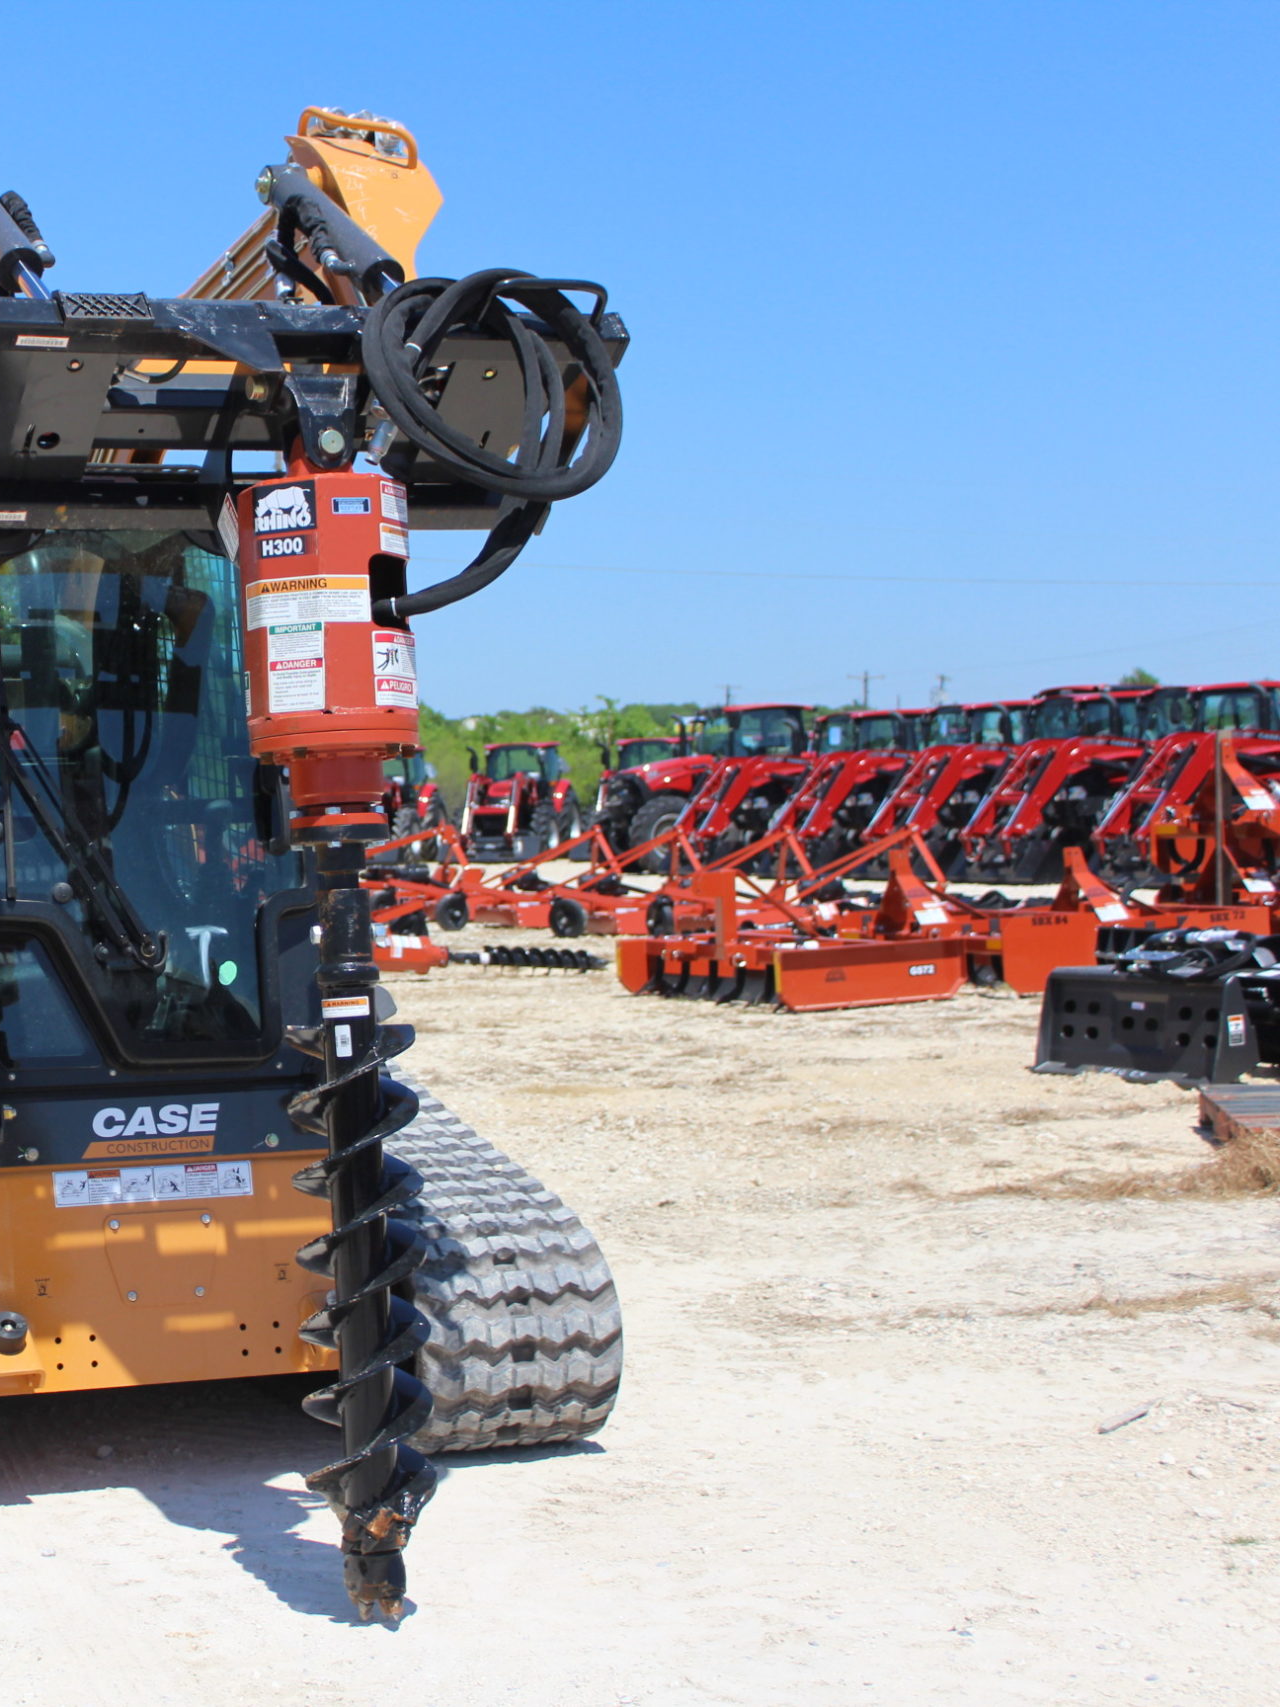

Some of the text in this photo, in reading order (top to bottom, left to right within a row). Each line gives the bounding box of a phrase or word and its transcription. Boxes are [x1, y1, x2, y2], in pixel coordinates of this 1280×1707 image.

[261, 537, 303, 556] H300
[270, 578, 327, 591] WARNING
[274, 623, 316, 633] IMPORTANT
[282, 660, 317, 669] DANGER
[389, 681, 411, 692] PELIGRO
[92, 1102, 220, 1137] CASE
[106, 1139, 210, 1154] CONSTRUCTION
